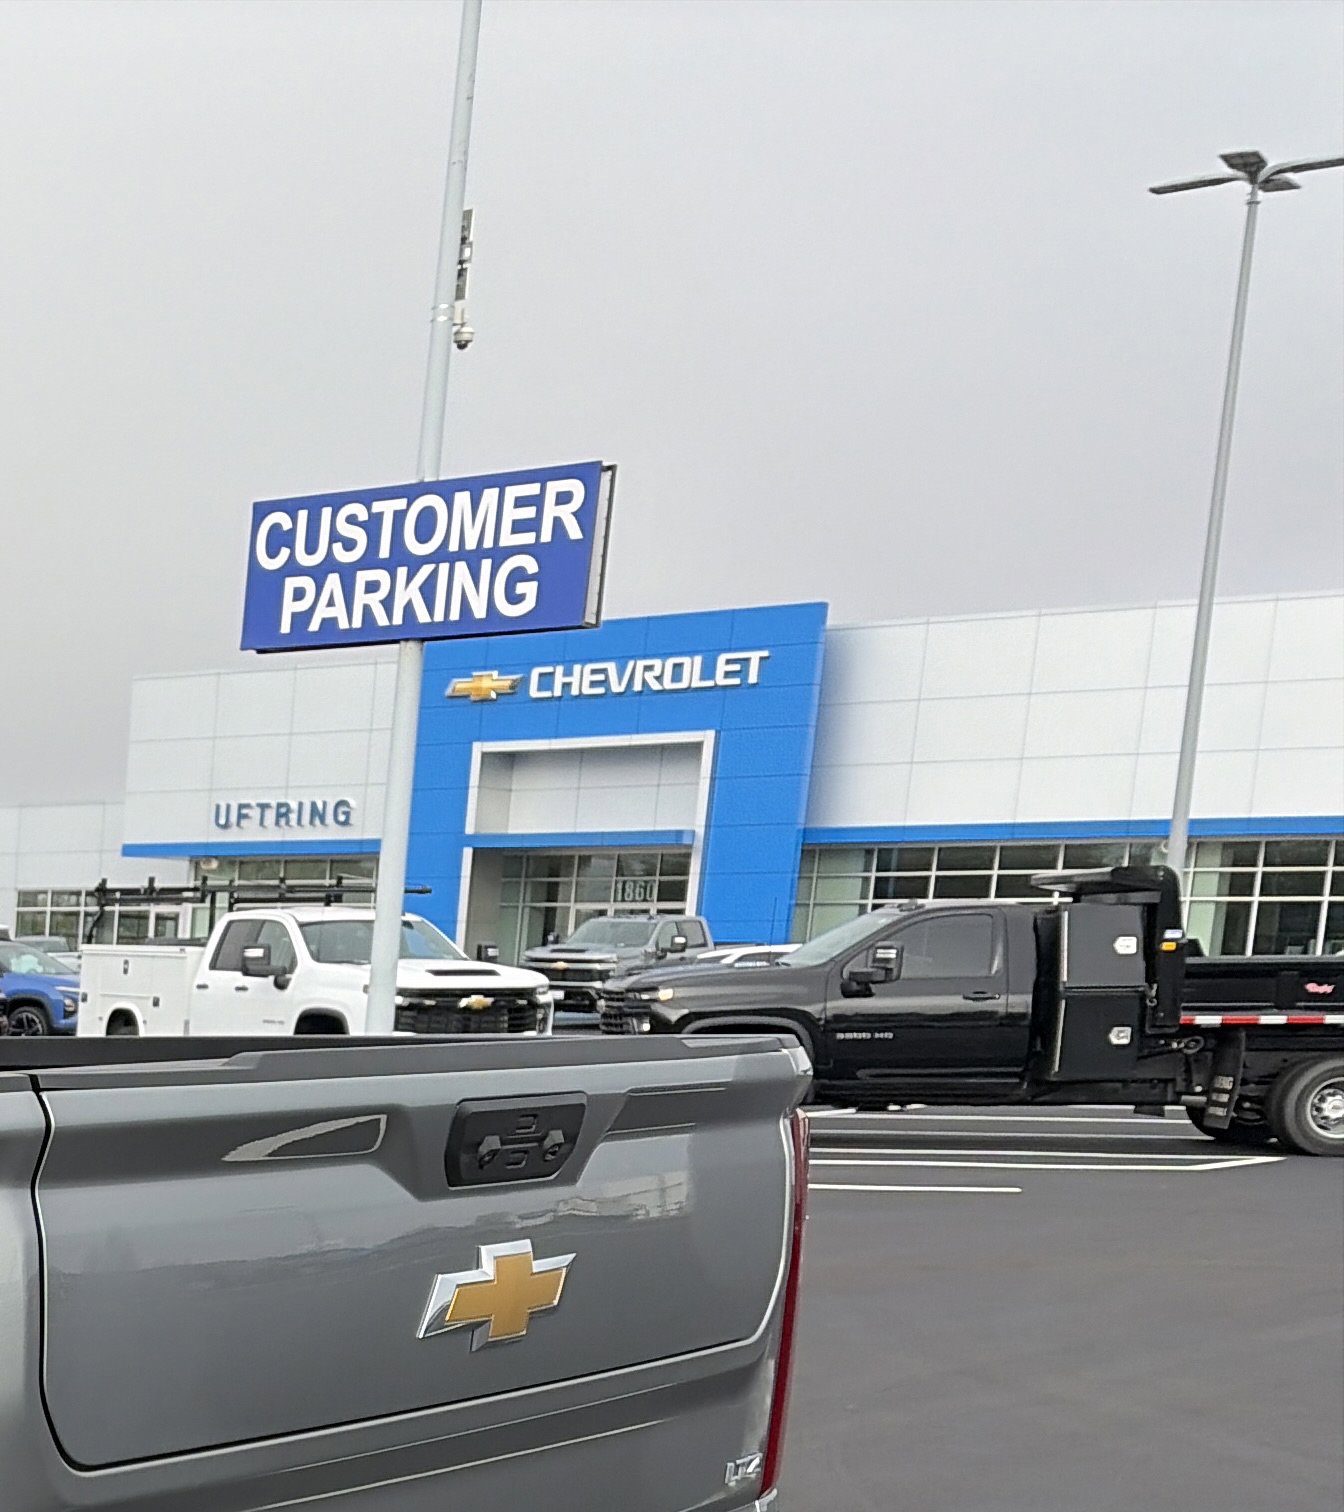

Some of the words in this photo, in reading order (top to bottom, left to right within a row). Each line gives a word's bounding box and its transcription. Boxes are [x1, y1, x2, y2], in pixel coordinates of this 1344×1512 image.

[256, 478, 585, 570] CUSTOMER
[280, 554, 539, 633] PARKING
[529, 650, 769, 698] CHEVROLET
[214, 799, 352, 829] UFTRING
[616, 880, 657, 901] 1860
[725, 1452, 763, 1486] LTZ
